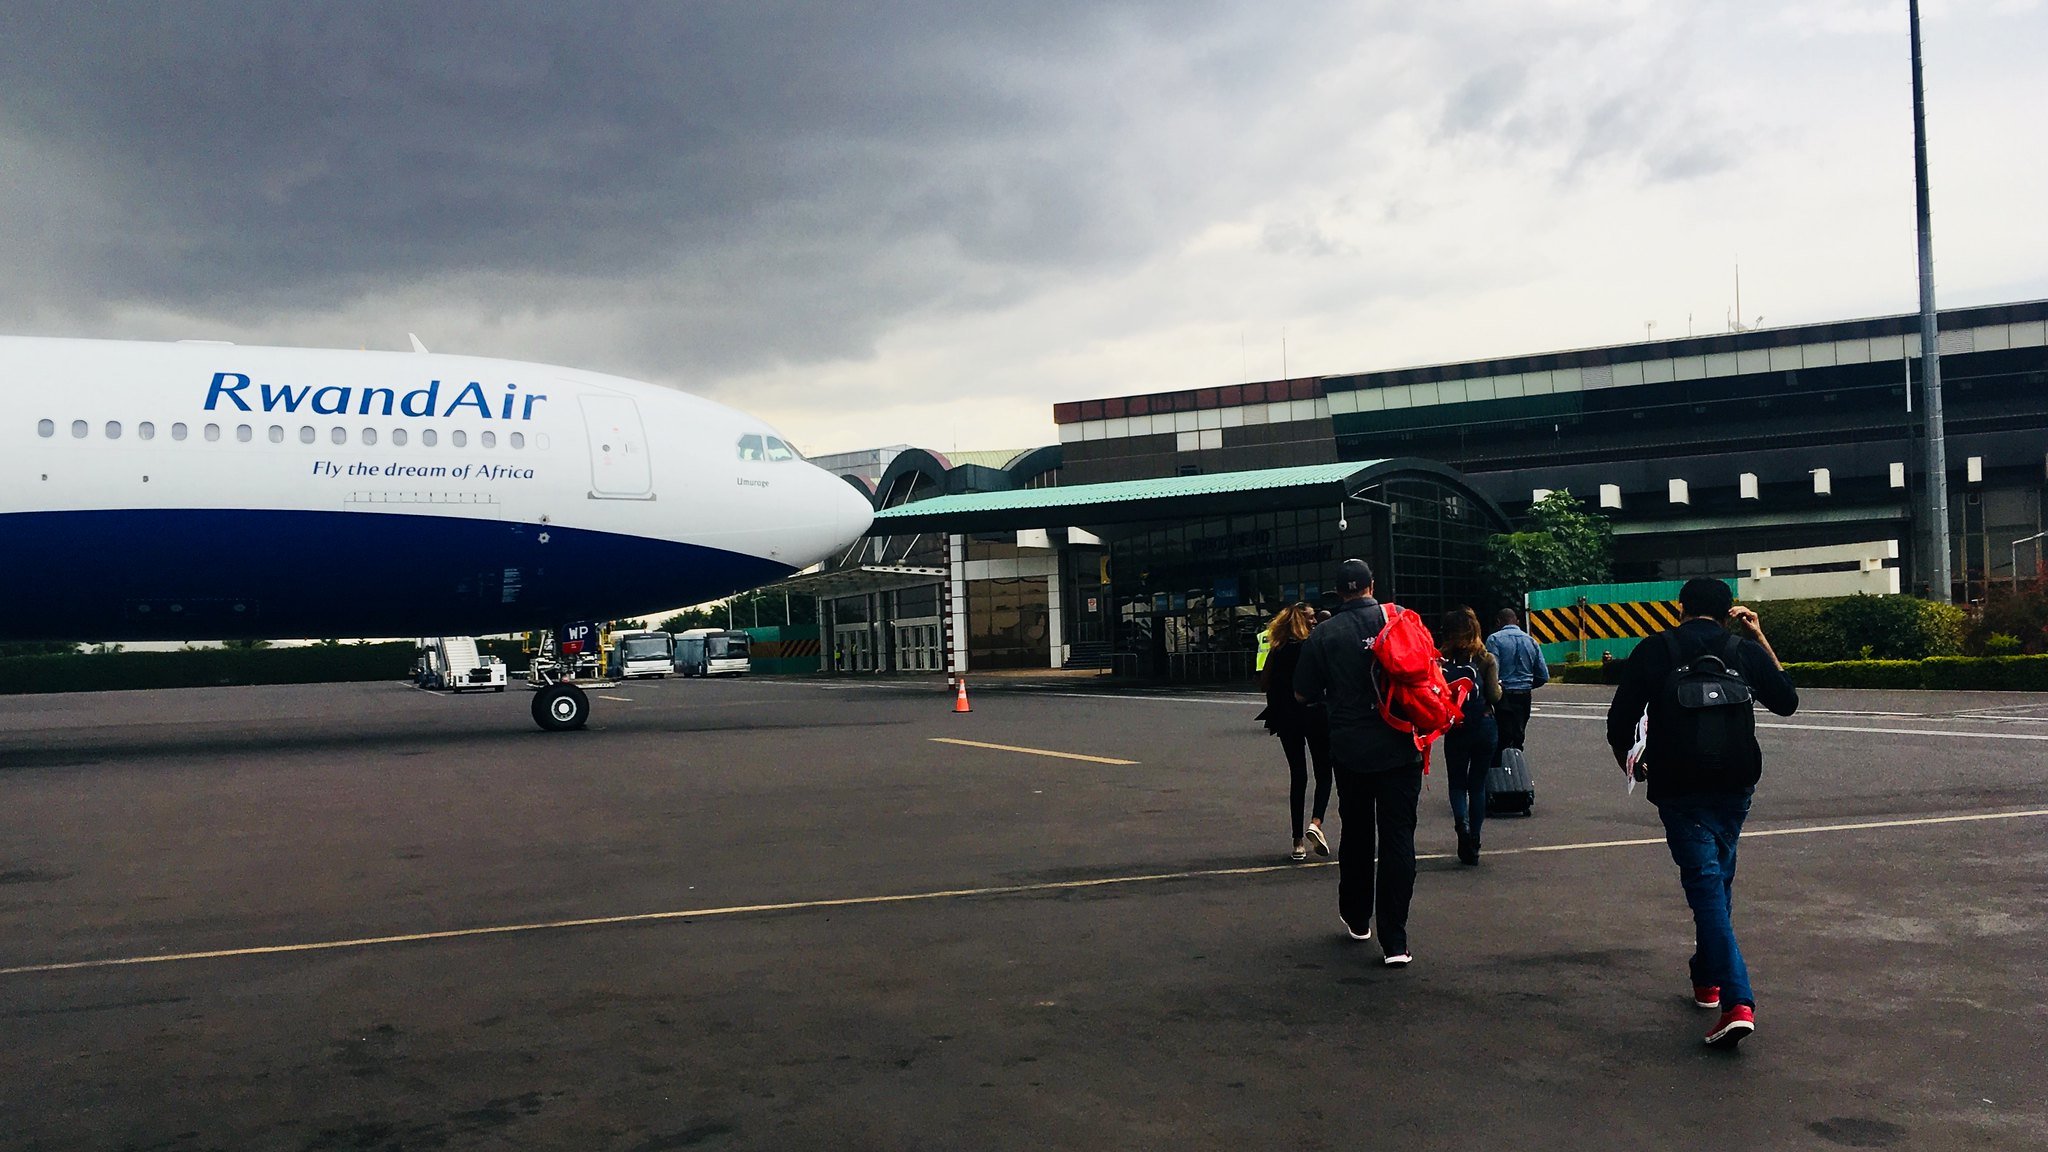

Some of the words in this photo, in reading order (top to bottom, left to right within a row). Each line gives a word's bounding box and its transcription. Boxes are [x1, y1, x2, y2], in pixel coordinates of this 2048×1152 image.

[203, 372, 547, 420] RwandAir
[312, 461, 343, 479] Fly
[348, 462, 379, 476] the
[385, 462, 447, 478] dream
[452, 464, 472, 480] of
[476, 464, 535, 481] Africa
[569, 626, 589, 640] WP
